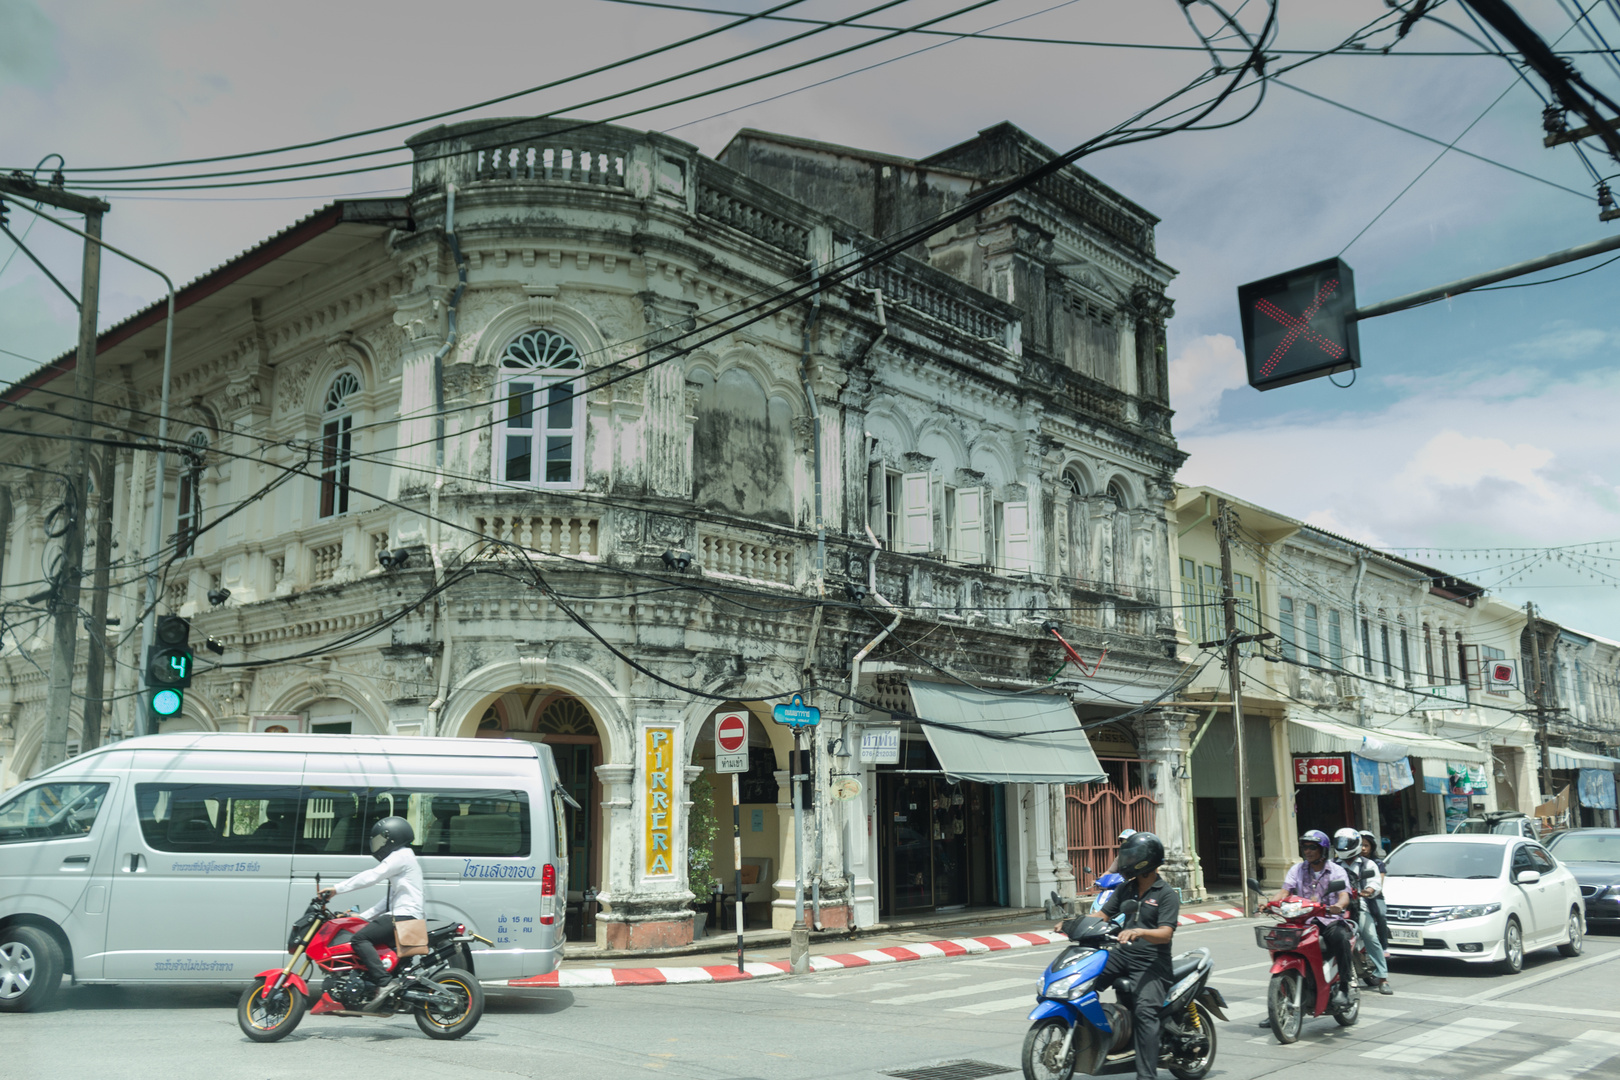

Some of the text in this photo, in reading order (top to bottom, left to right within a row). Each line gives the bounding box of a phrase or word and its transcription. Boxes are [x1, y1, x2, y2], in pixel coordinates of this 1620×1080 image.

[171, 656, 186, 678] 4
[862, 731, 897, 747] ทำฟัน
[721, 756, 743, 768] ห้ามเข้า
[651, 731, 669, 873] PIRRERA
[235, 862, 246, 872] 15
[497, 914, 508, 923] นั่ง
[497, 925, 508, 934] ยืน
[1402, 930, 1419, 938] 7244
